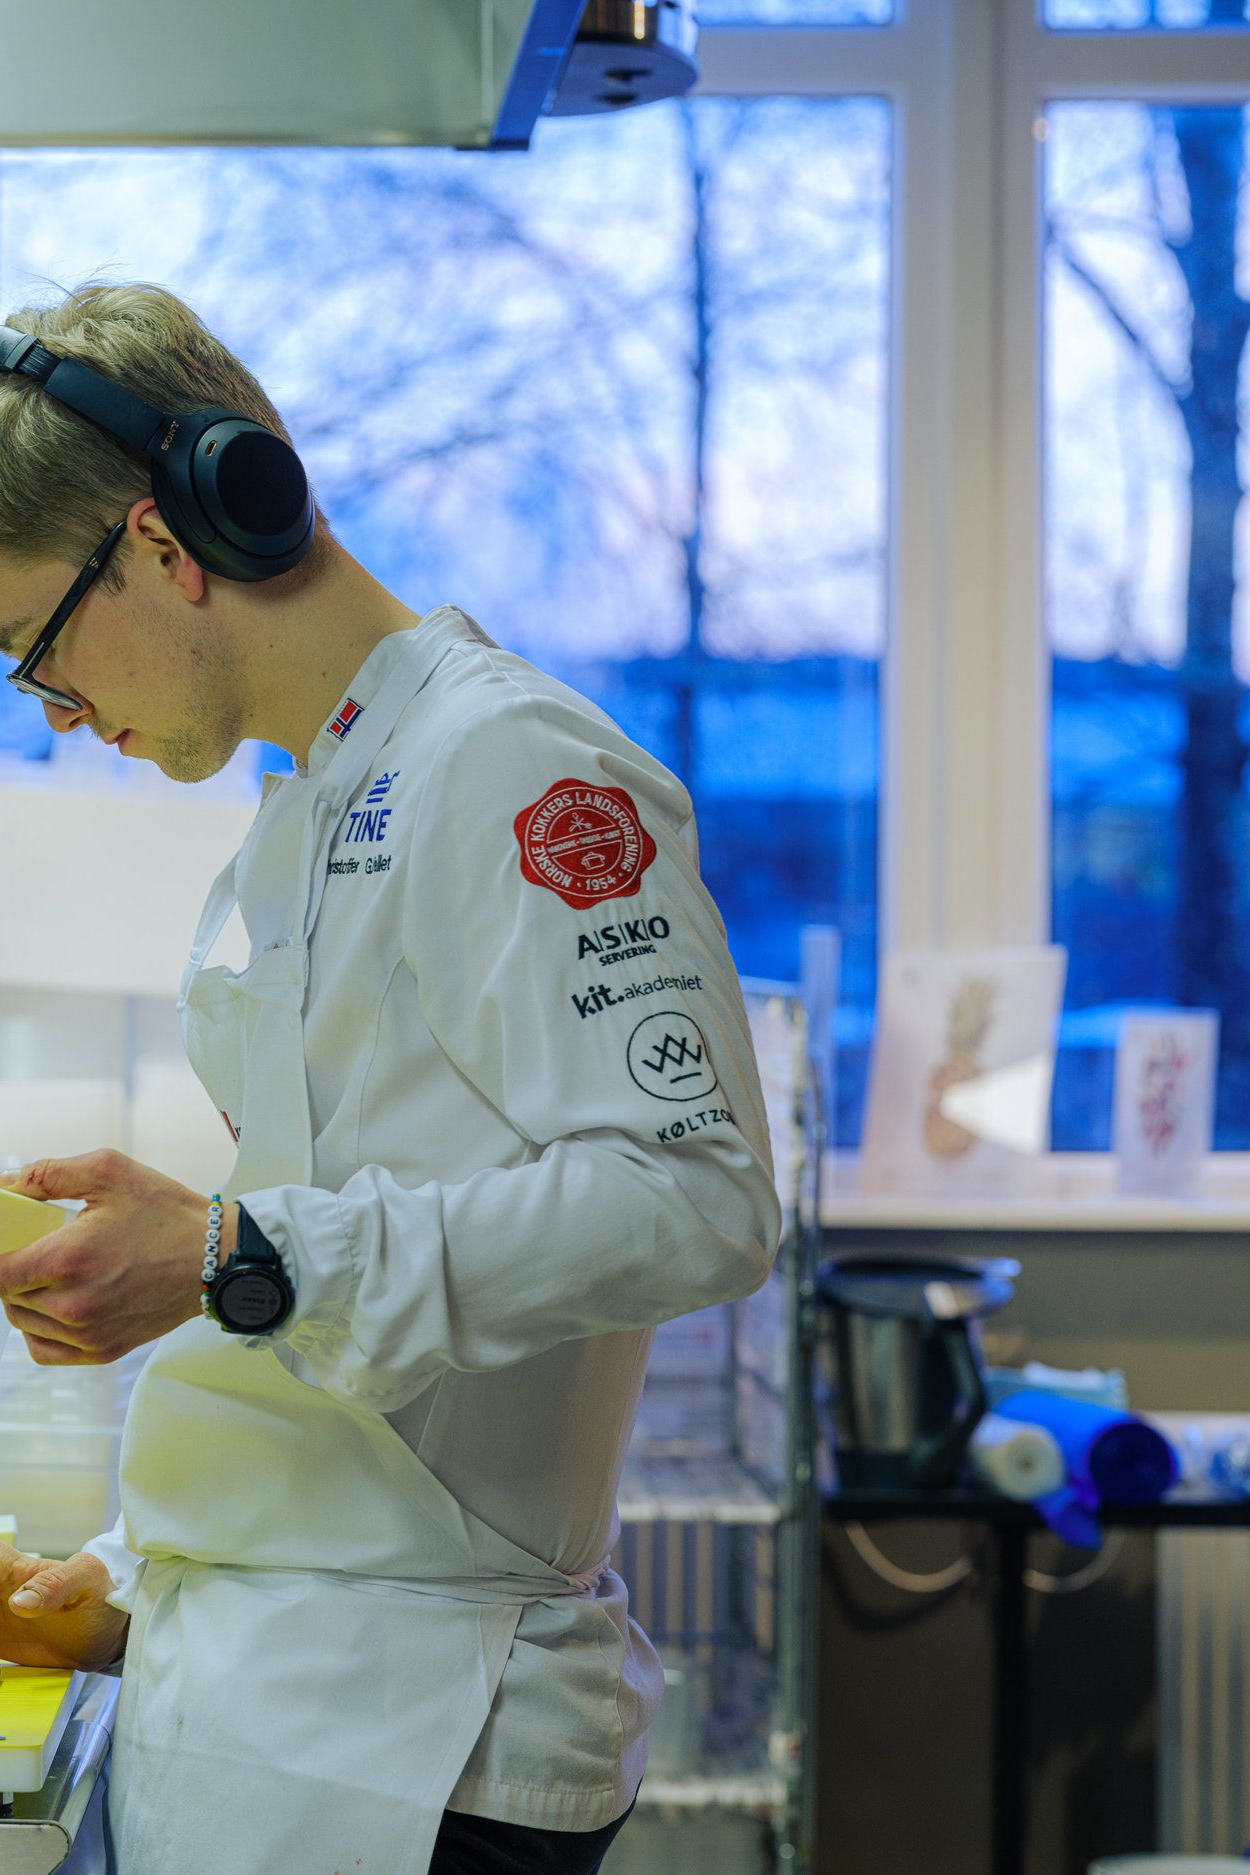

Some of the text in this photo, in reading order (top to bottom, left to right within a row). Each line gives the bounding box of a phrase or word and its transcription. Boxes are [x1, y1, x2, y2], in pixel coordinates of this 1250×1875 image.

[161, 420, 180, 451] SONY
[345, 808, 393, 843] TINE
[530, 793, 573, 842] KOKKERS
[575, 791, 639, 872] LANDSFORENING
[531, 844, 573, 888] NORSKE
[585, 874, 617, 891] 1954
[598, 944, 657, 967] SERVERING
[203, 1205, 221, 1281] CANCER
